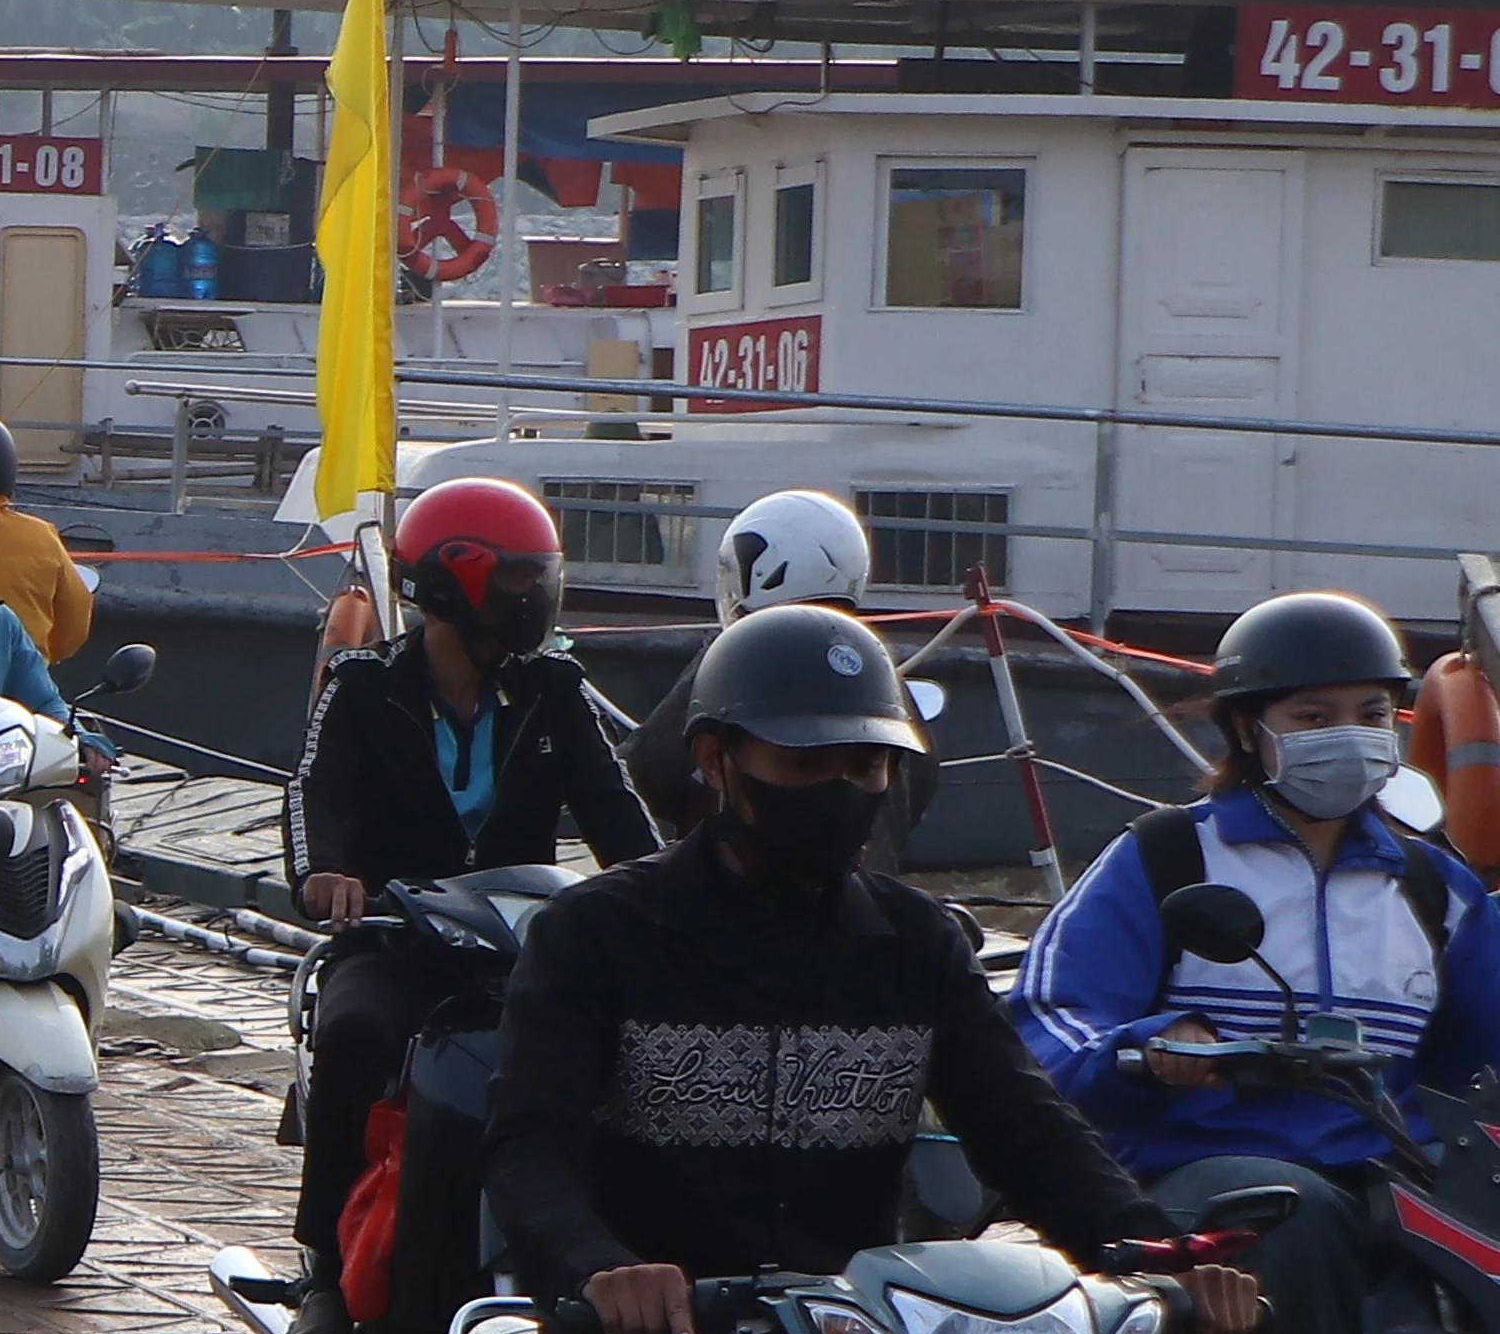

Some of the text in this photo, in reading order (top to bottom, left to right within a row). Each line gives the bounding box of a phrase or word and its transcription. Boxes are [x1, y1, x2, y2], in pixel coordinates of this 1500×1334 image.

[1259, 20, 1500, 95] 42-31-
[700, 329, 809, 404] 42-31-06
[782, 1050, 913, 1120] Vuitton
